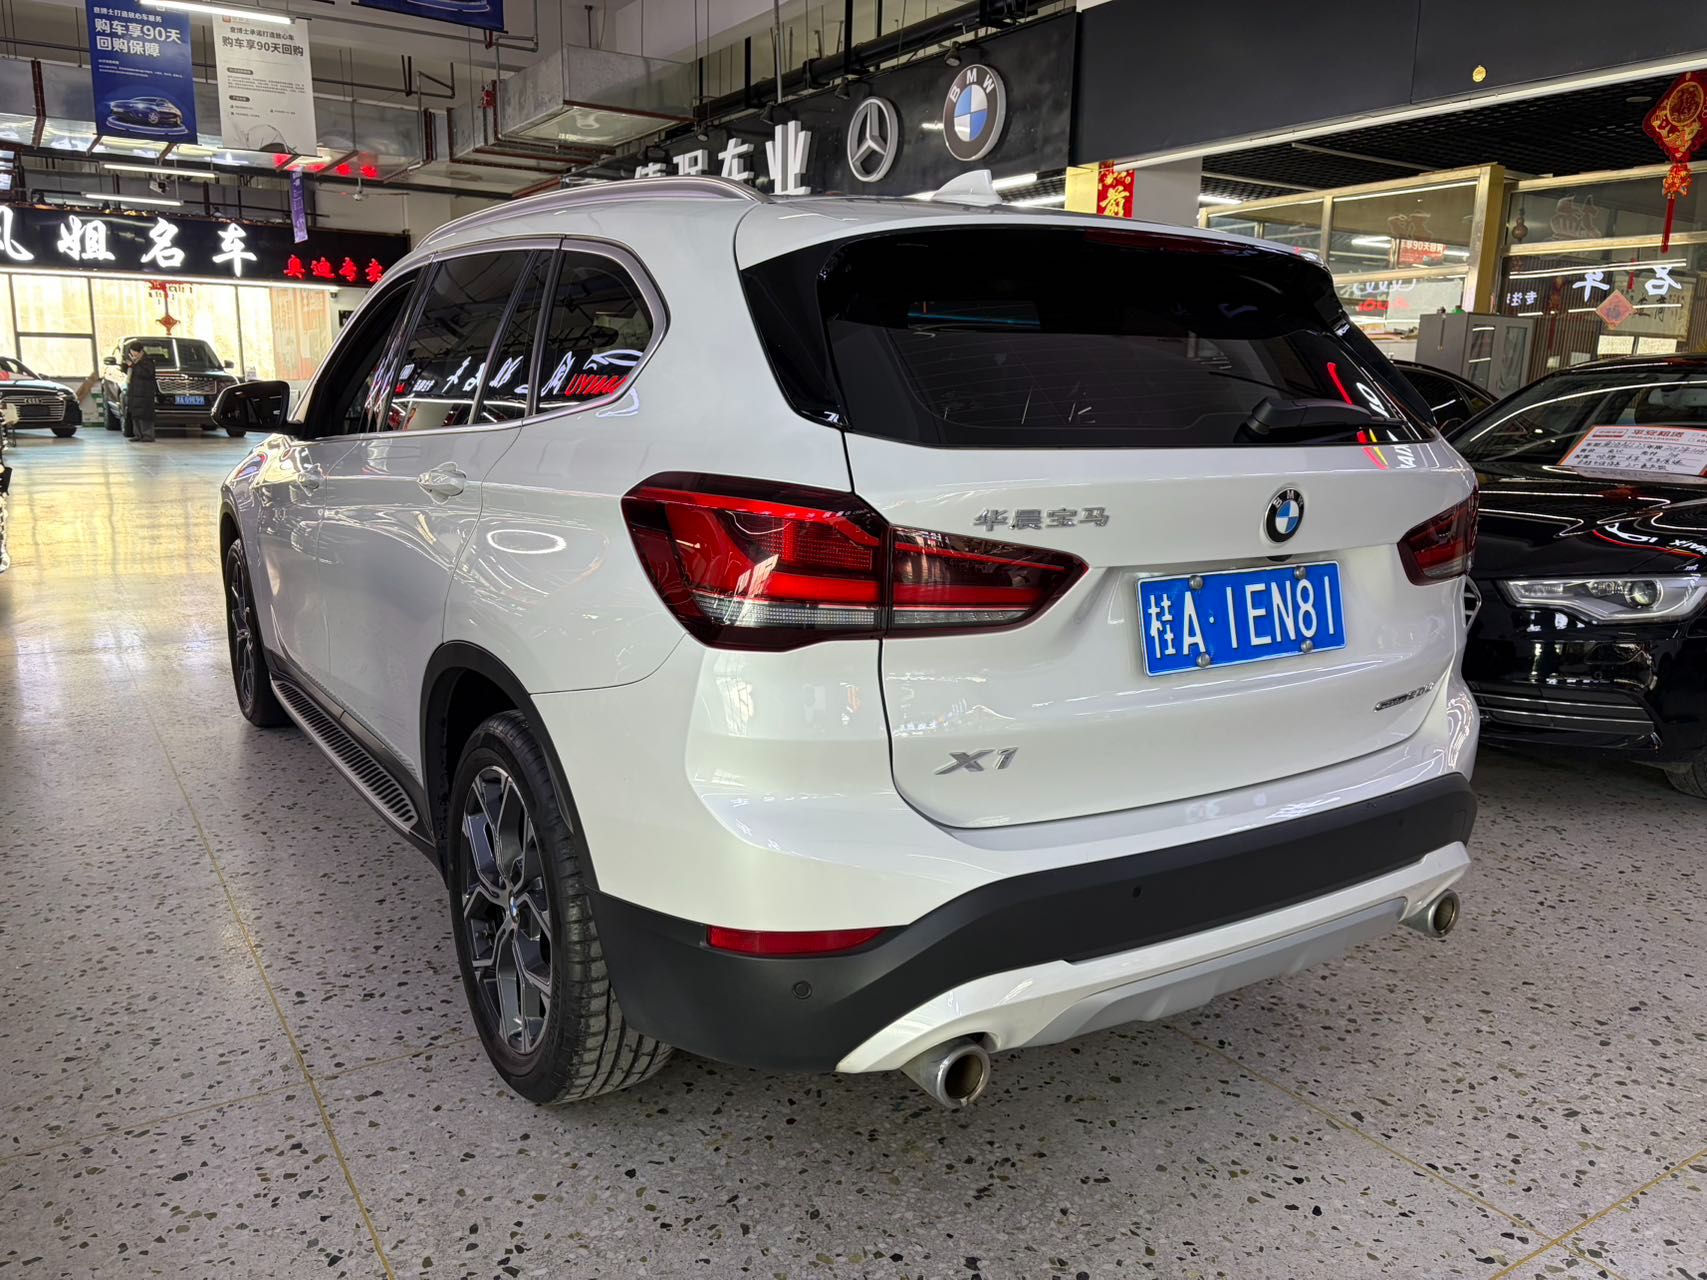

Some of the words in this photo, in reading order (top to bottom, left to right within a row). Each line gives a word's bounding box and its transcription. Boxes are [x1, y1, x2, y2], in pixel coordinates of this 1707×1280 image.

[95, 18, 182, 44] 购车享90天
[96, 36, 160, 57] 回购保障
[222, 36, 304, 57] 购车享90天回购
[950, 67, 995, 103] BMW
[973, 506, 1110, 532] 华晨宝马
[934, 747, 1019, 776] X1
